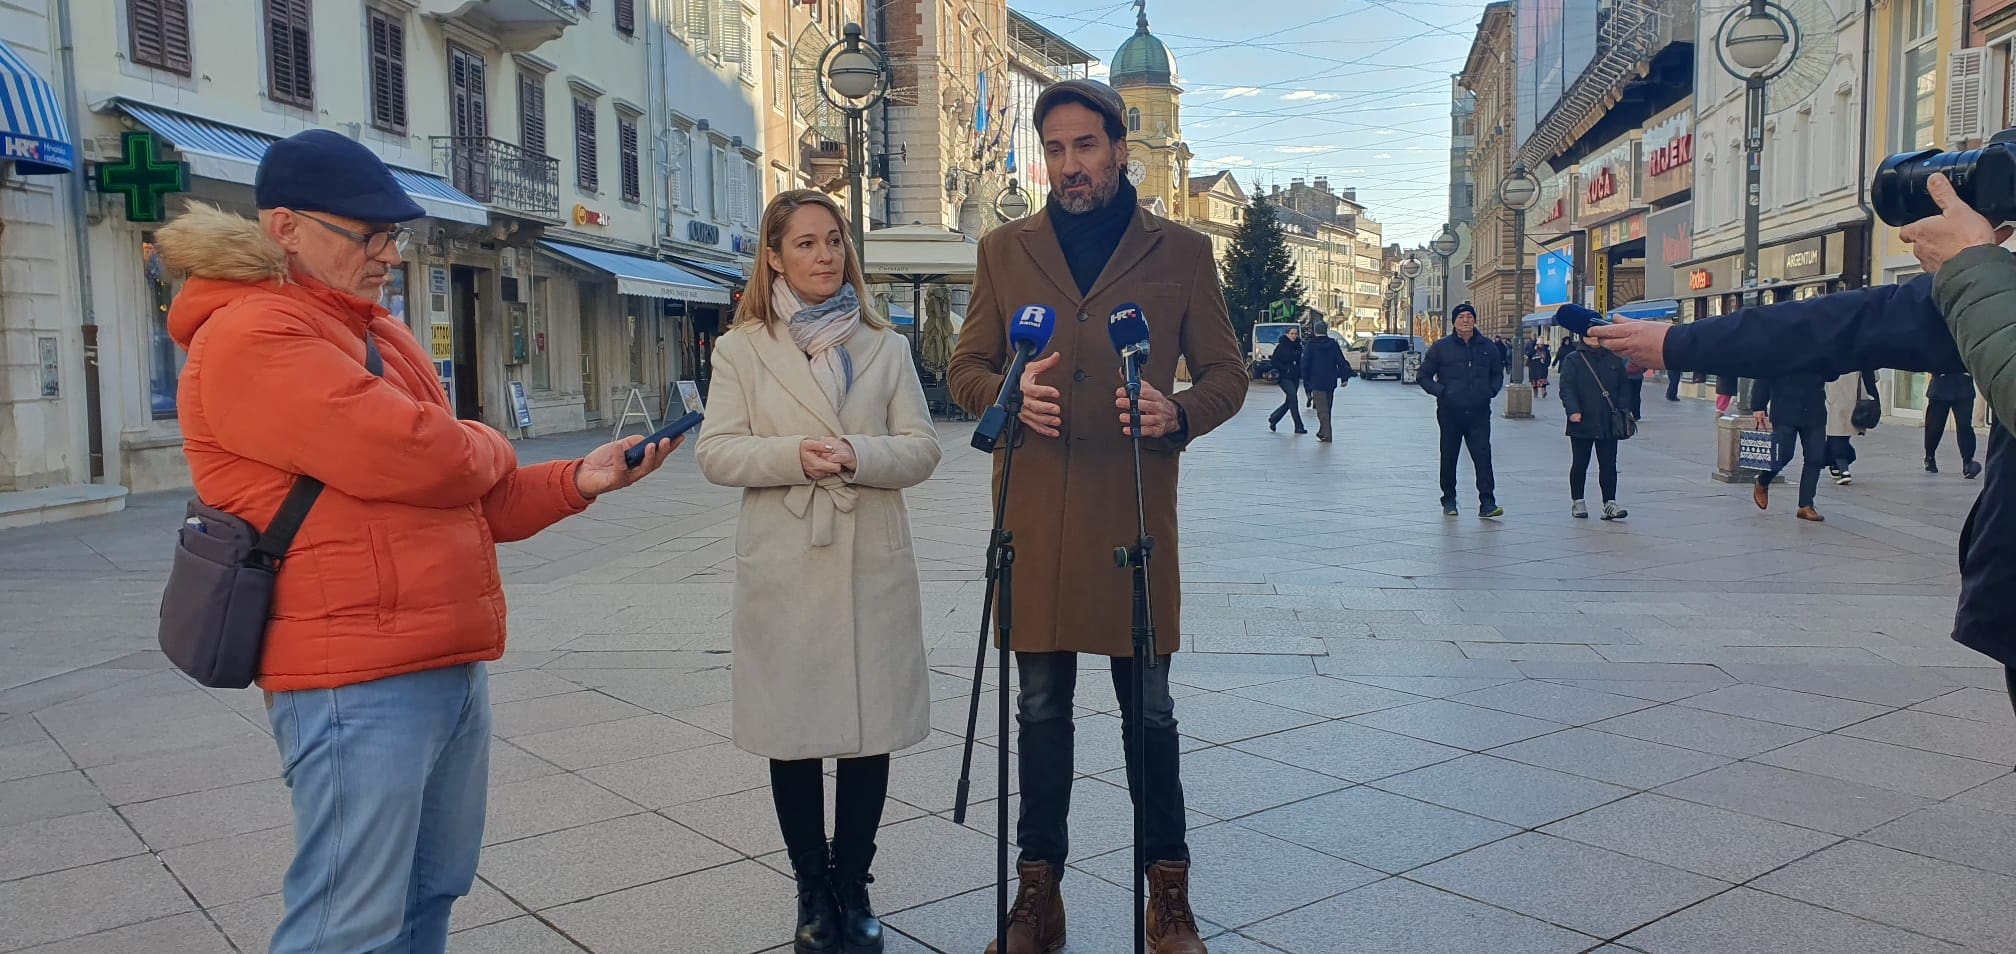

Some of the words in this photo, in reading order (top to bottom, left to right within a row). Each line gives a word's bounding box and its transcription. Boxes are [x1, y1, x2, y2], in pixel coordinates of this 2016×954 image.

[5, 136, 39, 160] HRT
[1786, 249, 1818, 269] ARGENTUM
[1020, 306, 1046, 322] R
[1110, 308, 1137, 324] HRT
